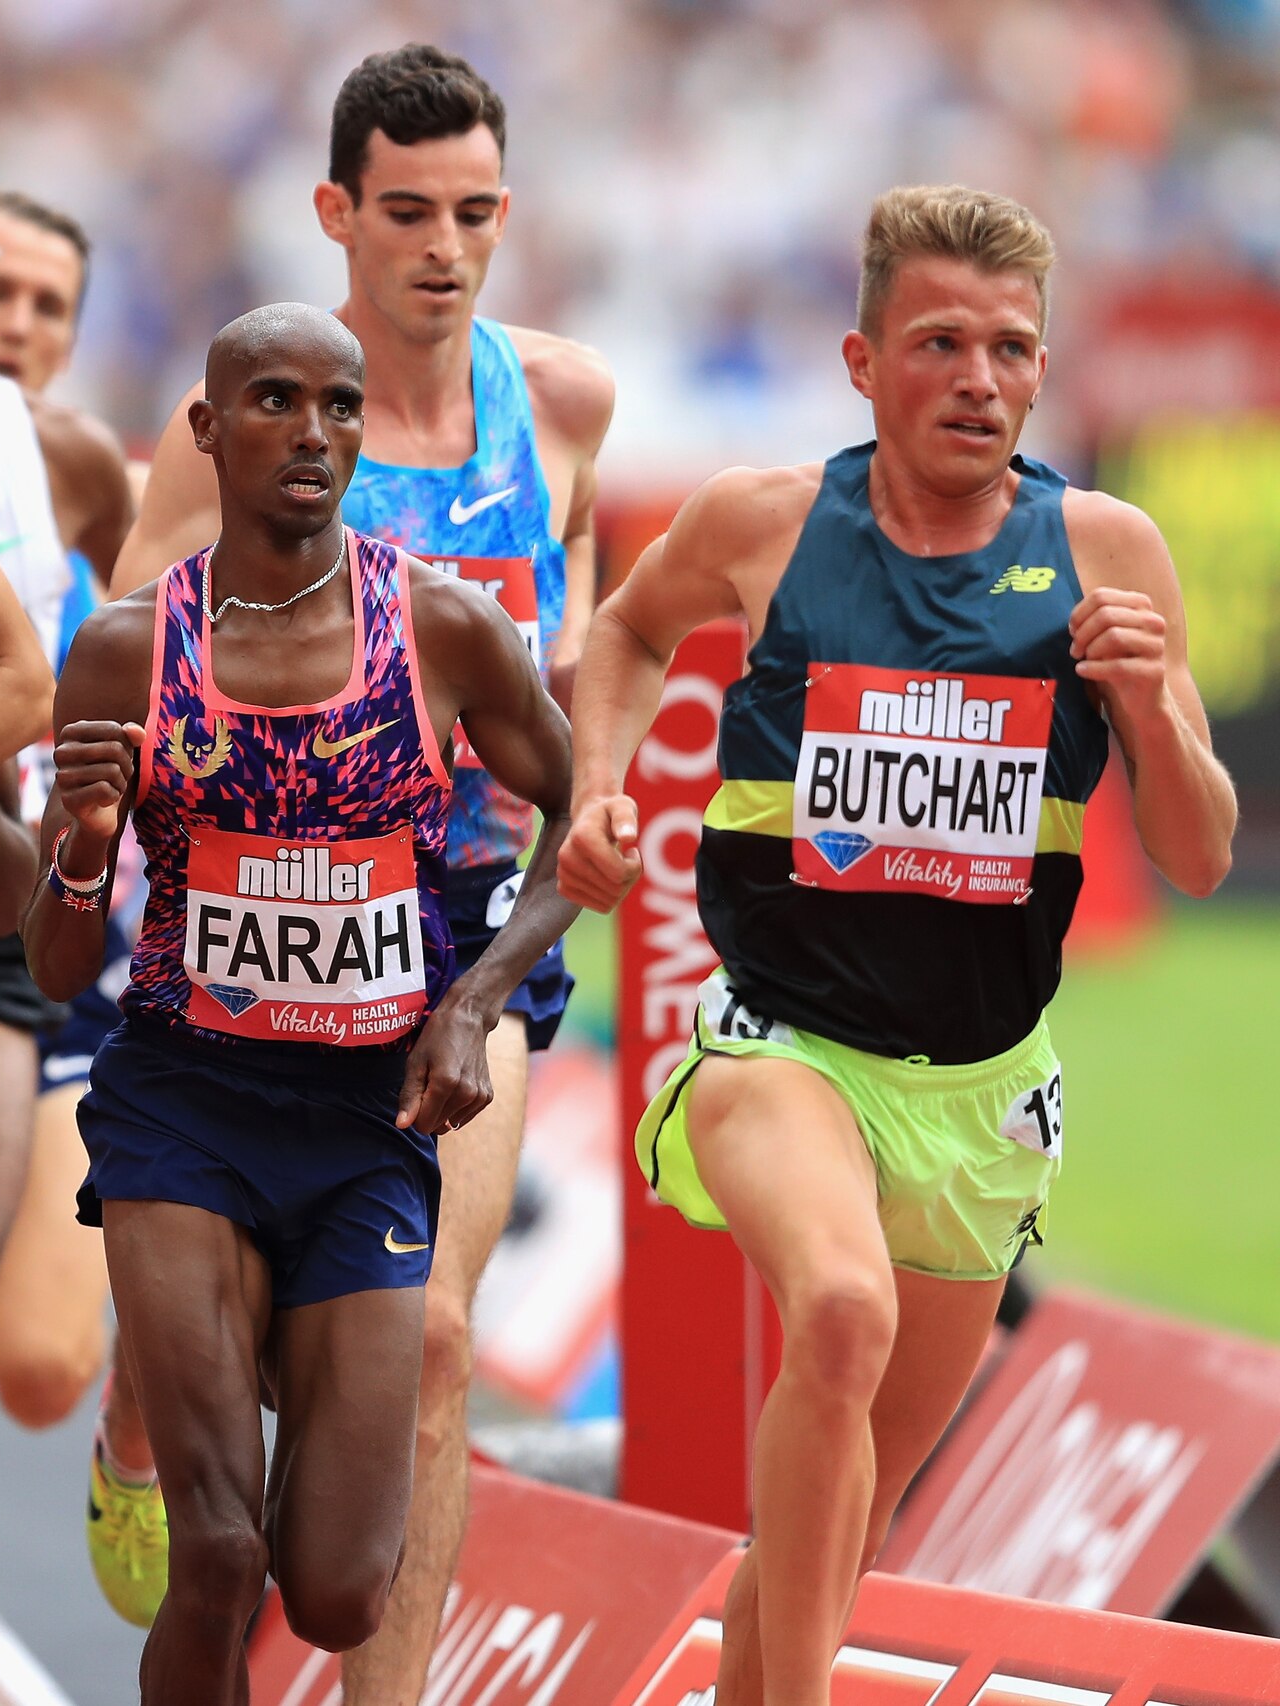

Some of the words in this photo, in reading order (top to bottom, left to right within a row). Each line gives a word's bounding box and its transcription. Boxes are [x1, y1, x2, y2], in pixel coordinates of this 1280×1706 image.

[859, 678, 1012, 743] müller
[807, 745, 1038, 836] BUTCHART
[236, 847, 375, 902] müller
[883, 848, 963, 898] Vitality
[970, 860, 1011, 876] HEALTH
[196, 902, 412, 985] FARAH
[269, 1003, 348, 1044] Vitality
[352, 1002, 399, 1021] HEALTH
[352, 1011, 418, 1036] INSURANCE
